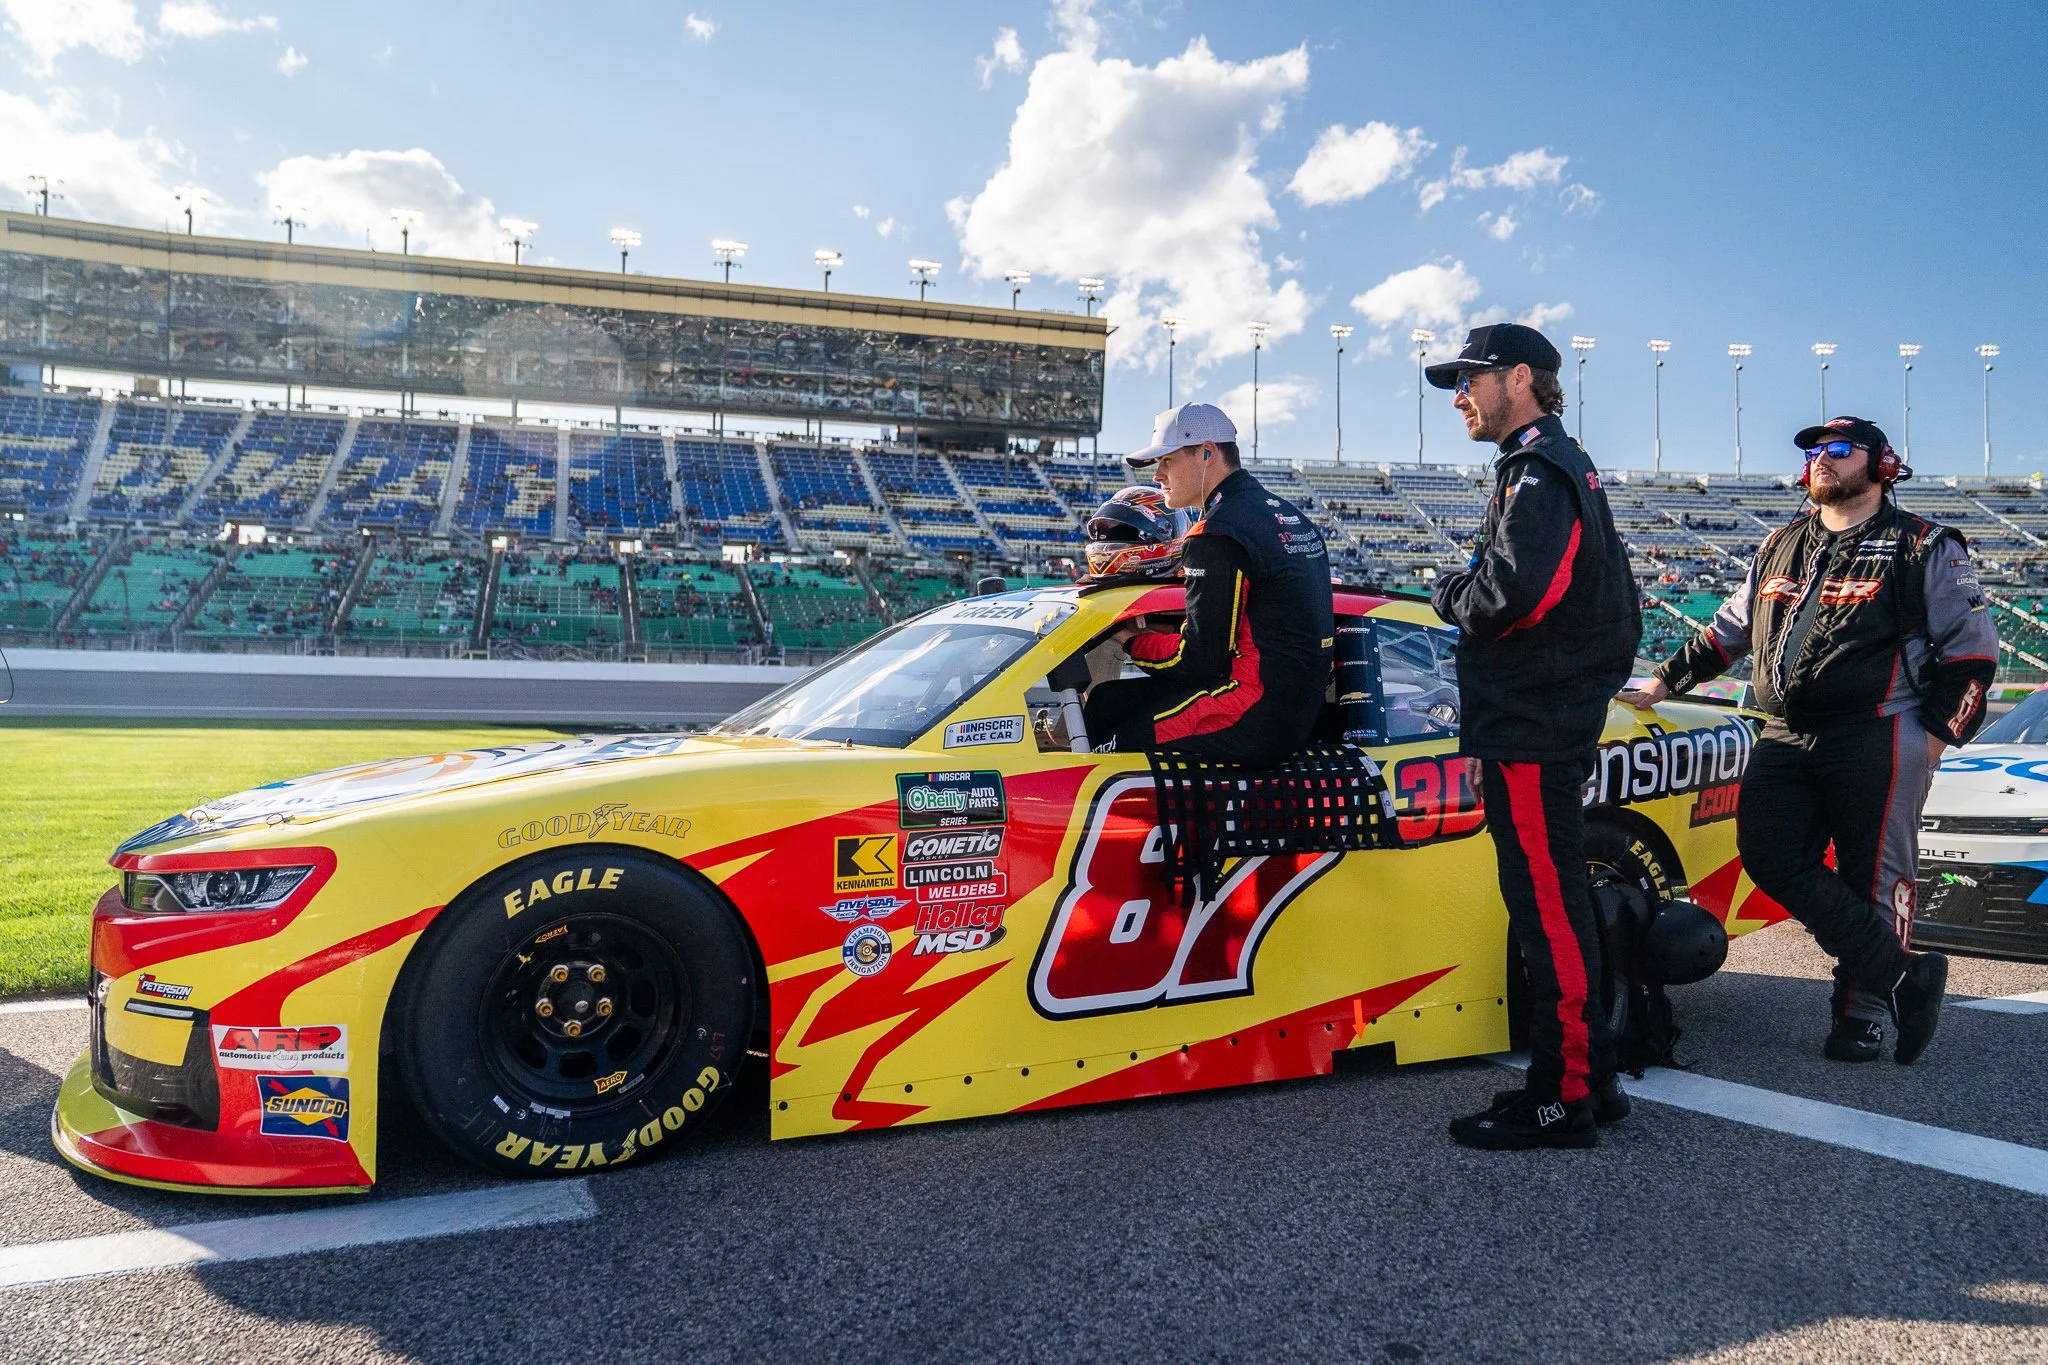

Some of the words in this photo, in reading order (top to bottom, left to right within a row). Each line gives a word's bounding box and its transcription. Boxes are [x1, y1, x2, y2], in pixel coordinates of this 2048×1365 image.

[953, 607, 1034, 619] GREEN
[970, 720, 1013, 732] NASCAR
[956, 733, 985, 743] RACE
[990, 731, 1012, 741] CAR
[939, 772, 970, 782] NASCAR
[908, 787, 967, 812] O'Reilly
[970, 787, 995, 798] AUTO
[968, 797, 998, 809] PARTS
[497, 803, 692, 848] GOODYEAR
[939, 817, 968, 827] SERIES
[907, 833, 1000, 857] COMETIC
[909, 866, 989, 884] LINCOLN
[1629, 840, 1673, 900] EAGLE
[836, 878, 895, 890] KENNAMETAL
[928, 883, 997, 898] WELDERS
[504, 868, 625, 918] EAGLE
[1030, 772, 1345, 1019] 87
[837, 901, 863, 911] FIVE
[868, 898, 894, 907] STAR
[916, 903, 1005, 932] Holley
[848, 927, 887, 944] CHAMPION
[913, 929, 991, 956] MSD
[847, 955, 888, 974] IRRIGATION
[141, 979, 193, 996] PETERSON
[218, 1026, 342, 1051] ARP
[219, 1051, 272, 1060] automotive
[301, 1051, 345, 1061] products
[599, 1074, 622, 1090] AERO
[269, 1097, 347, 1117] SUNOCO
[495, 1066, 720, 1169] GOODYEAR
